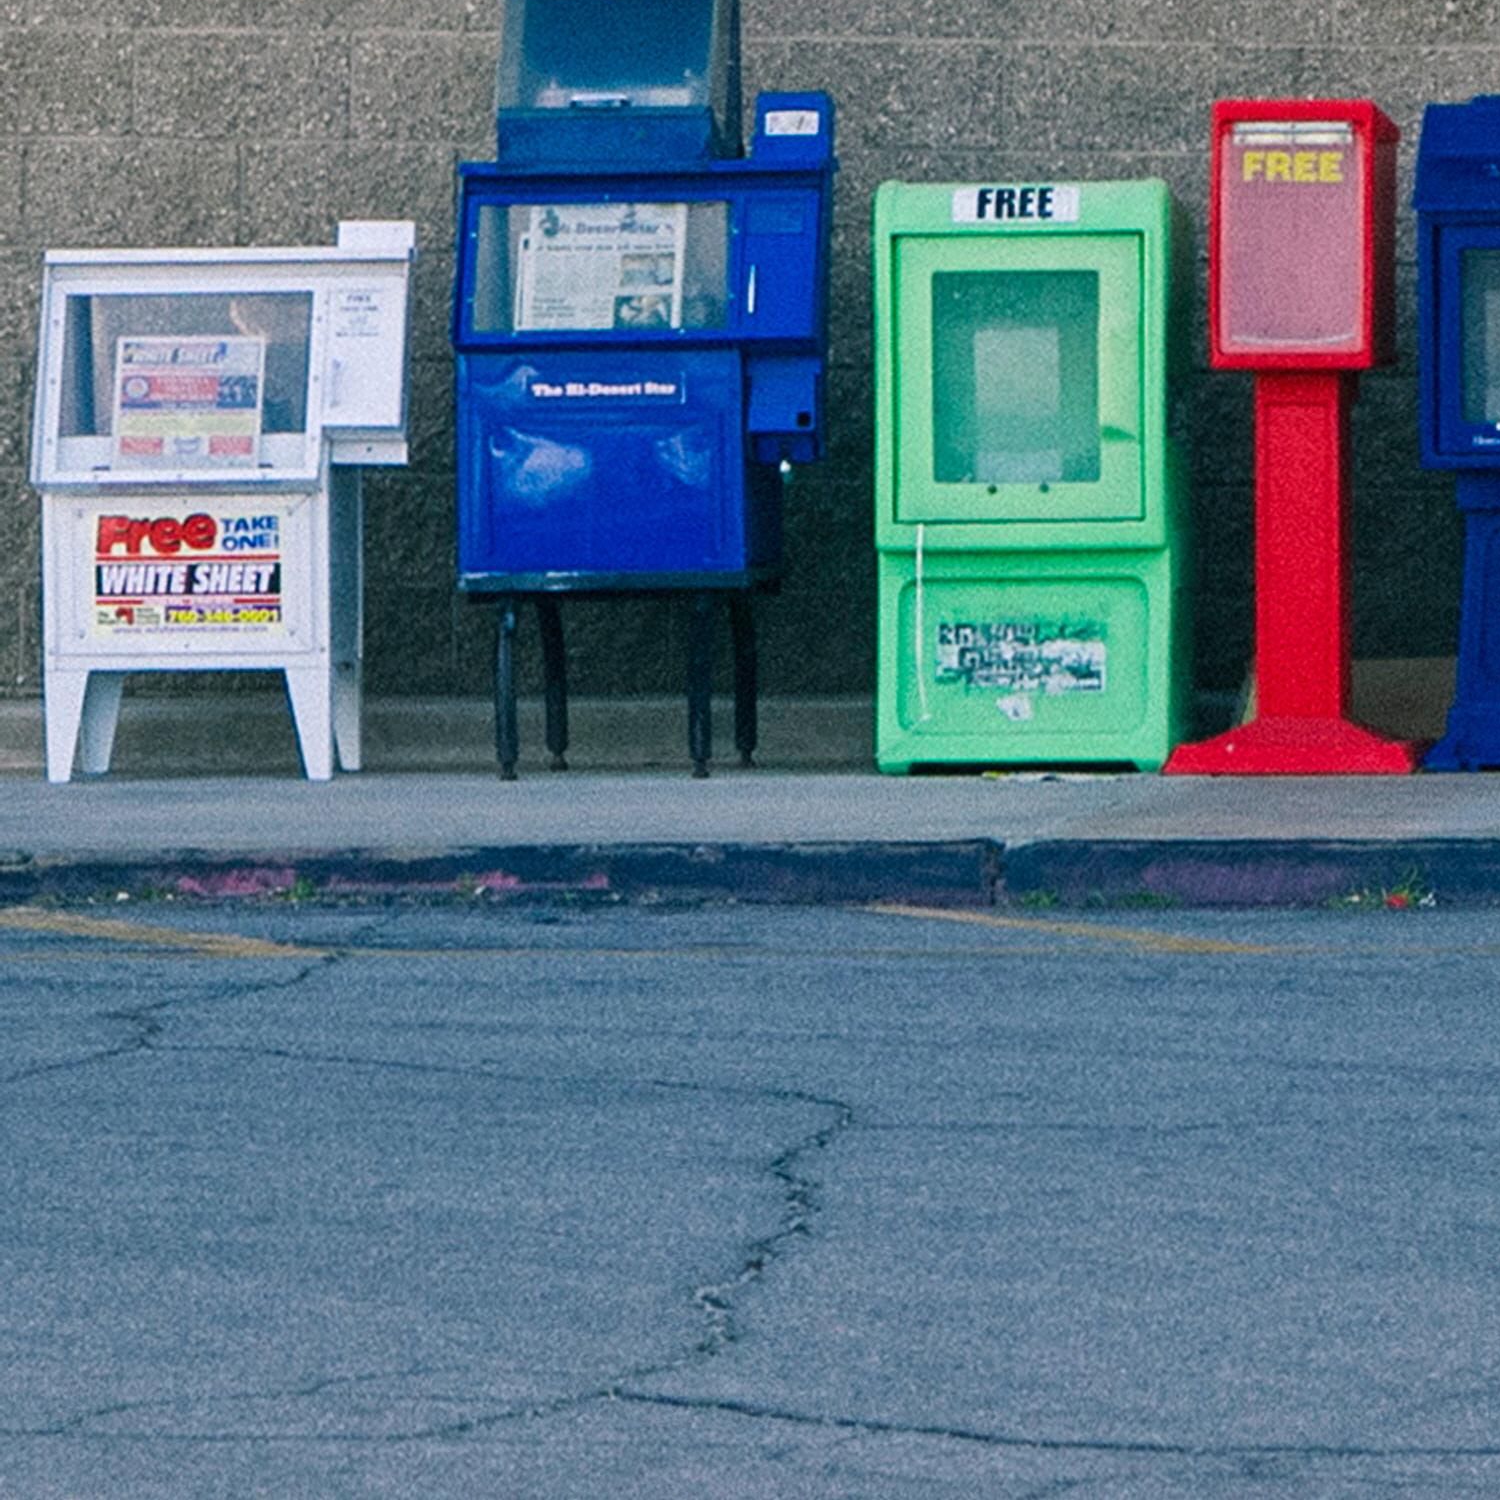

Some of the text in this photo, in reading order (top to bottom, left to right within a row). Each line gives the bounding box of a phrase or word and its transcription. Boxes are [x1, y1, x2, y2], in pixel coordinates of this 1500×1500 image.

[1243, 151, 1344, 182] FREE
[977, 187, 1054, 218] FREE
[531, 383, 563, 397] The
[96, 513, 217, 554] Free
[221, 515, 279, 533] TAKE
[222, 534, 279, 550] ONE!
[102, 564, 274, 594] WHITE SHEET
